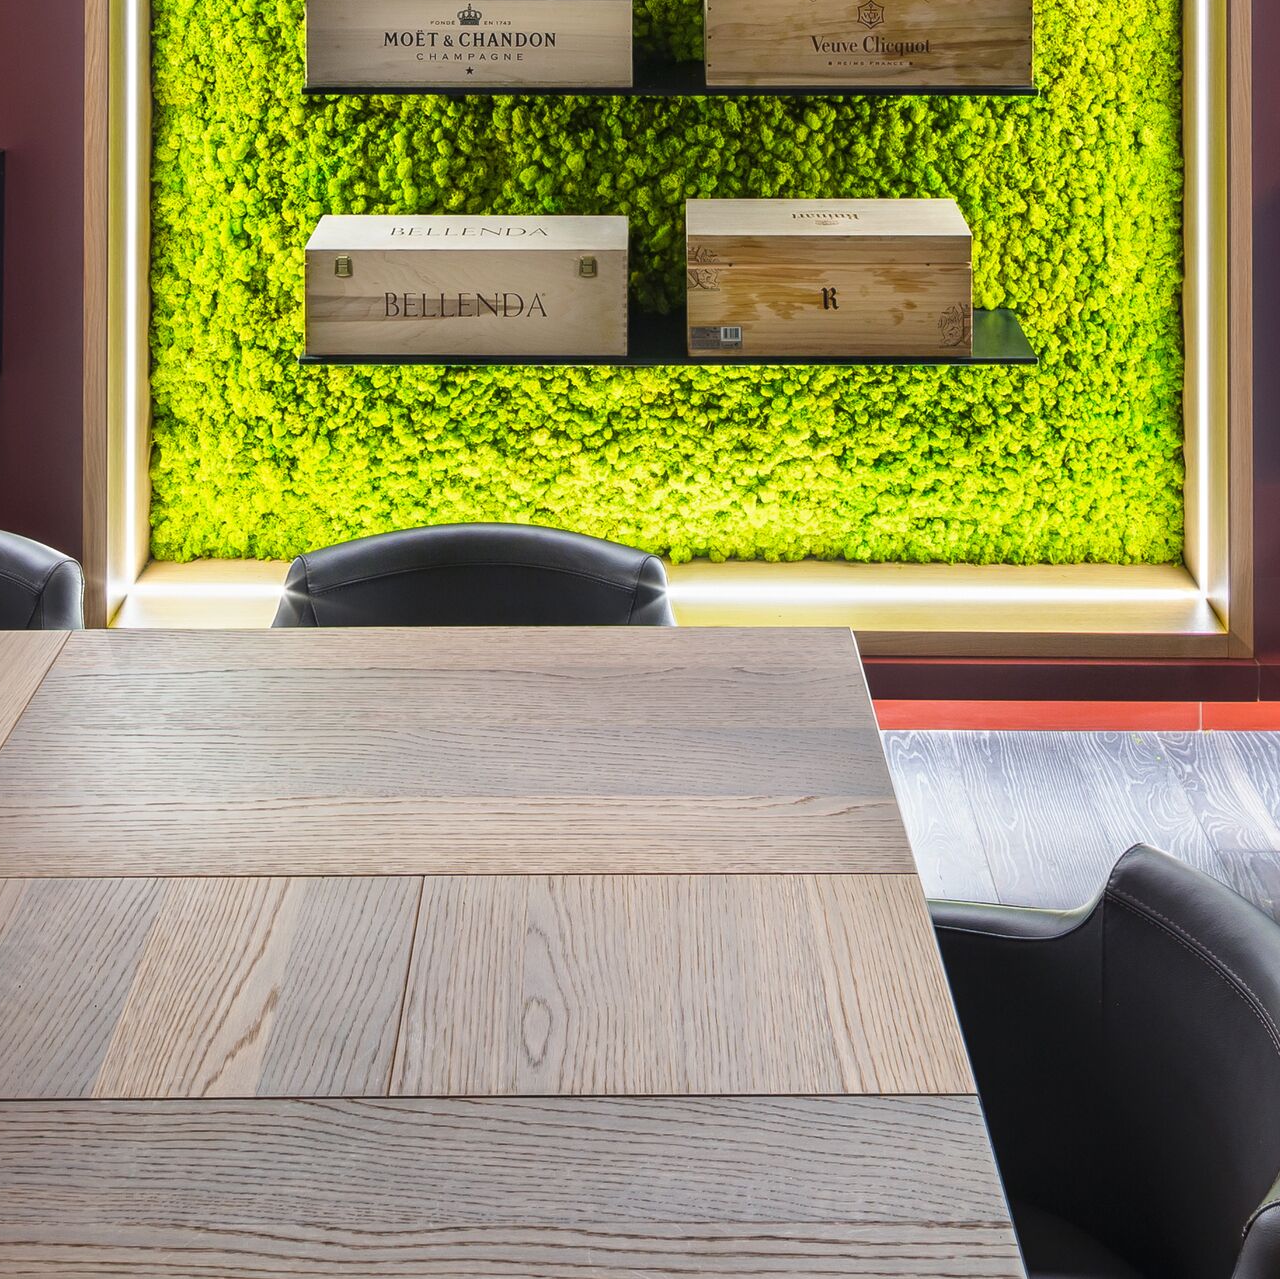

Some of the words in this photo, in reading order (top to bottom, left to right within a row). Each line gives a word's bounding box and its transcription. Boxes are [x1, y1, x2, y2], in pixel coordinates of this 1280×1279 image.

[383, 30, 439, 47] MOËT
[443, 36, 454, 47] &
[458, 32, 557, 48] CHANDON
[811, 35, 858, 53] Veuve
[863, 35, 931, 55] Clicquot
[416, 53, 524, 61] CHAMPAGNE
[390, 227, 548, 237] BELLENDA
[384, 292, 547, 318] BELLENDA
[821, 287, 839, 310] R
